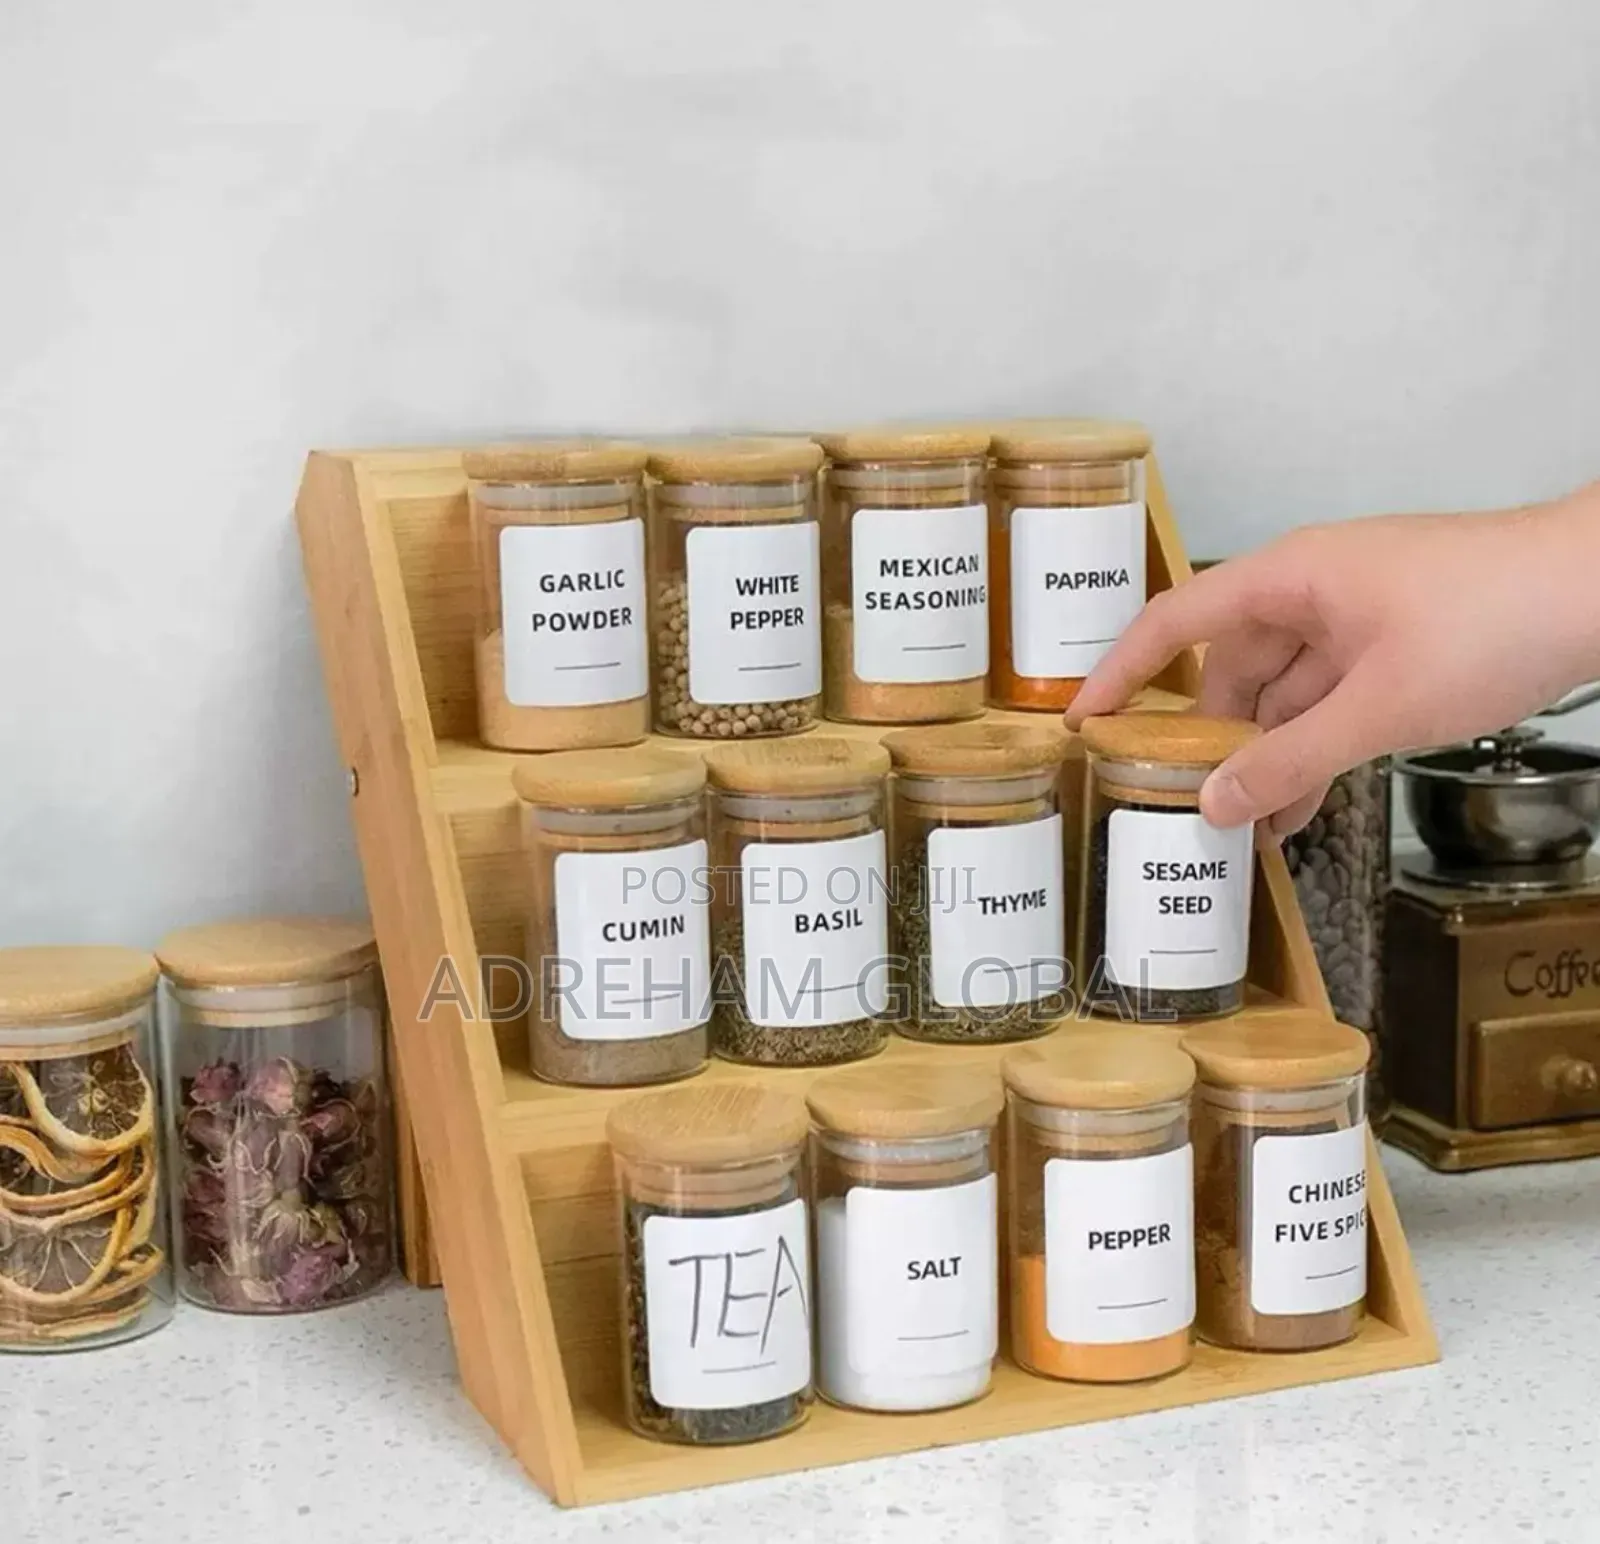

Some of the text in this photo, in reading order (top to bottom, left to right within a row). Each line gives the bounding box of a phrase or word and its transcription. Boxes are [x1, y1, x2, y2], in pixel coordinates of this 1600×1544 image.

[879, 553, 980, 578] MEXICAN
[539, 569, 626, 594] GARLIC
[736, 574, 800, 597] WHITE
[1045, 568, 1130, 591] PAPRIKA
[864, 584, 987, 611] SEASONING
[532, 606, 633, 632] POWDER
[730, 607, 805, 631] PEPPER
[1142, 860, 1229, 883] SESAME
[978, 888, 1048, 916] THYME
[1158, 894, 1213, 916] SEED
[602, 914, 685, 943] CUMIN
[794, 908, 864, 934] BASIL
[1088, 1222, 1172, 1251] PEPPER
[1275, 1207, 1366, 1243] FIVE SPIC
[906, 1256, 963, 1281] SALT
[667, 1234, 808, 1356] TEA
